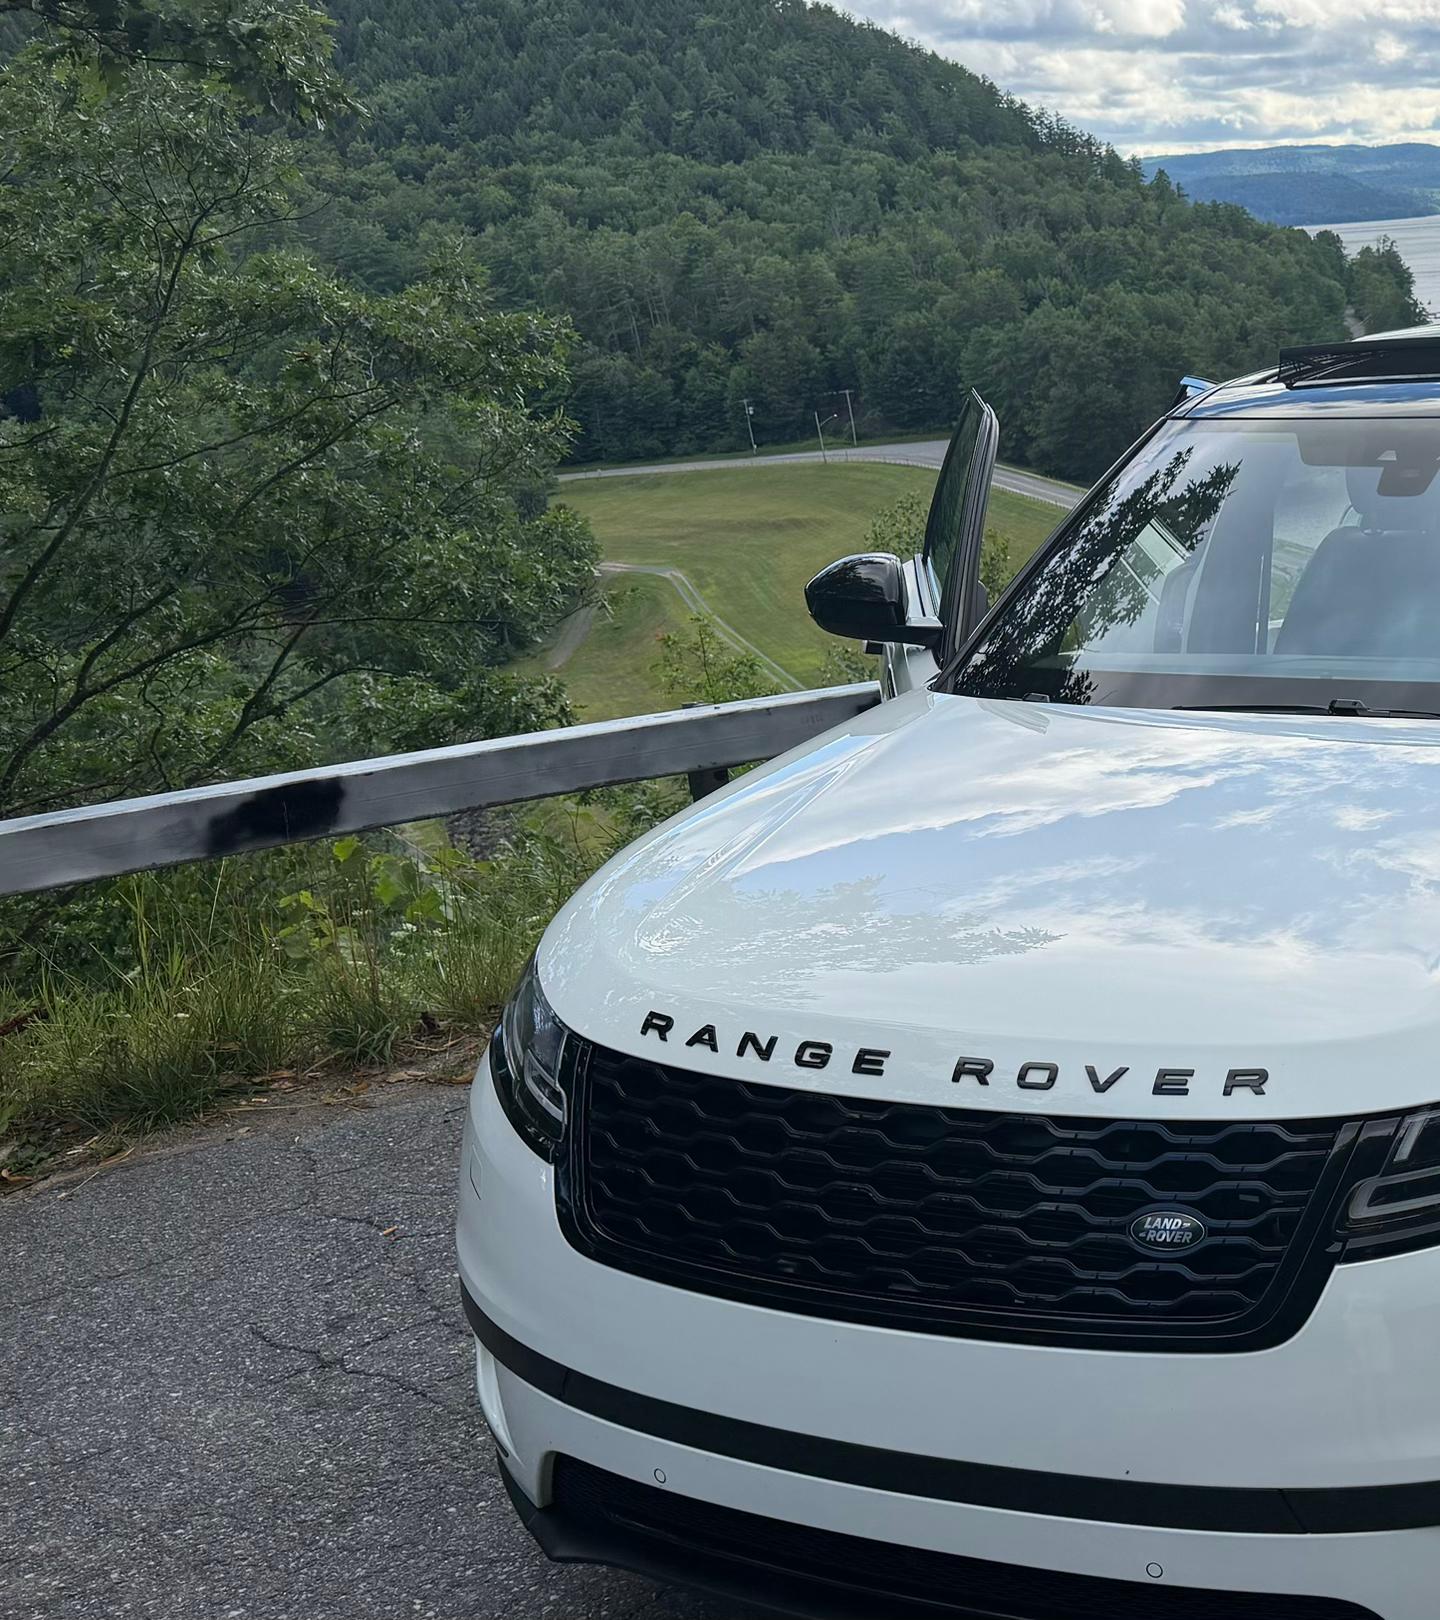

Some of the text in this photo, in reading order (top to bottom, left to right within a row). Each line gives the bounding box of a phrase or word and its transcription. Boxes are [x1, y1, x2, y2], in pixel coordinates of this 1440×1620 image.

[640, 1010, 1269, 1097] RANGE ROVER
[1144, 1217, 1182, 1229] LAND
[1146, 1230, 1193, 1243] ROVER
